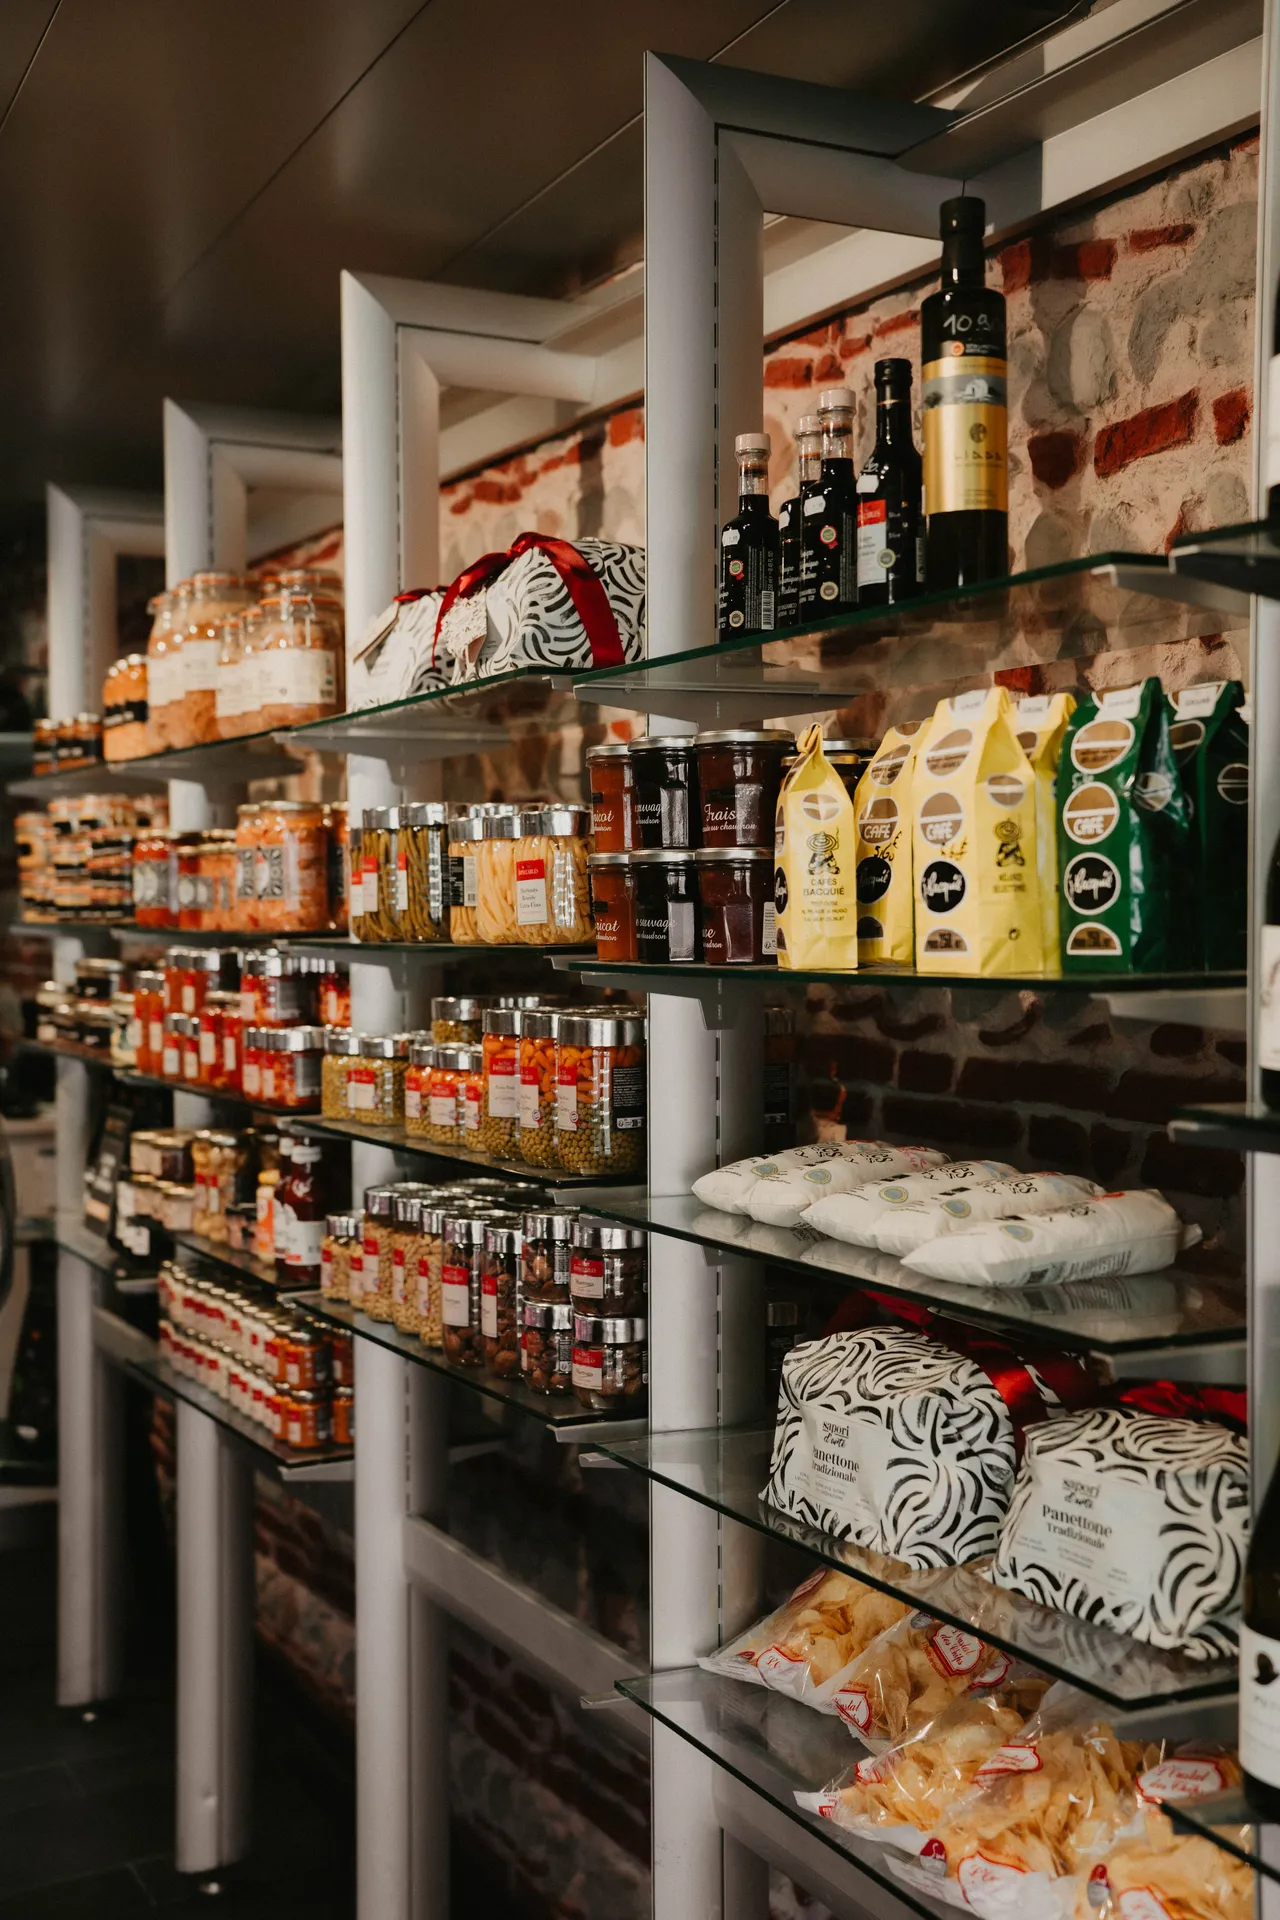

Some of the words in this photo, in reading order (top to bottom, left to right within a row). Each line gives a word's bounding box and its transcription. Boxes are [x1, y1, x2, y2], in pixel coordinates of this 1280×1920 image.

[704, 804, 747, 822] Fraise
[803, 886, 845, 896] BACQUIÉ
[822, 1421, 850, 1438] sapori
[1042, 1504, 1113, 1539] Panettone
